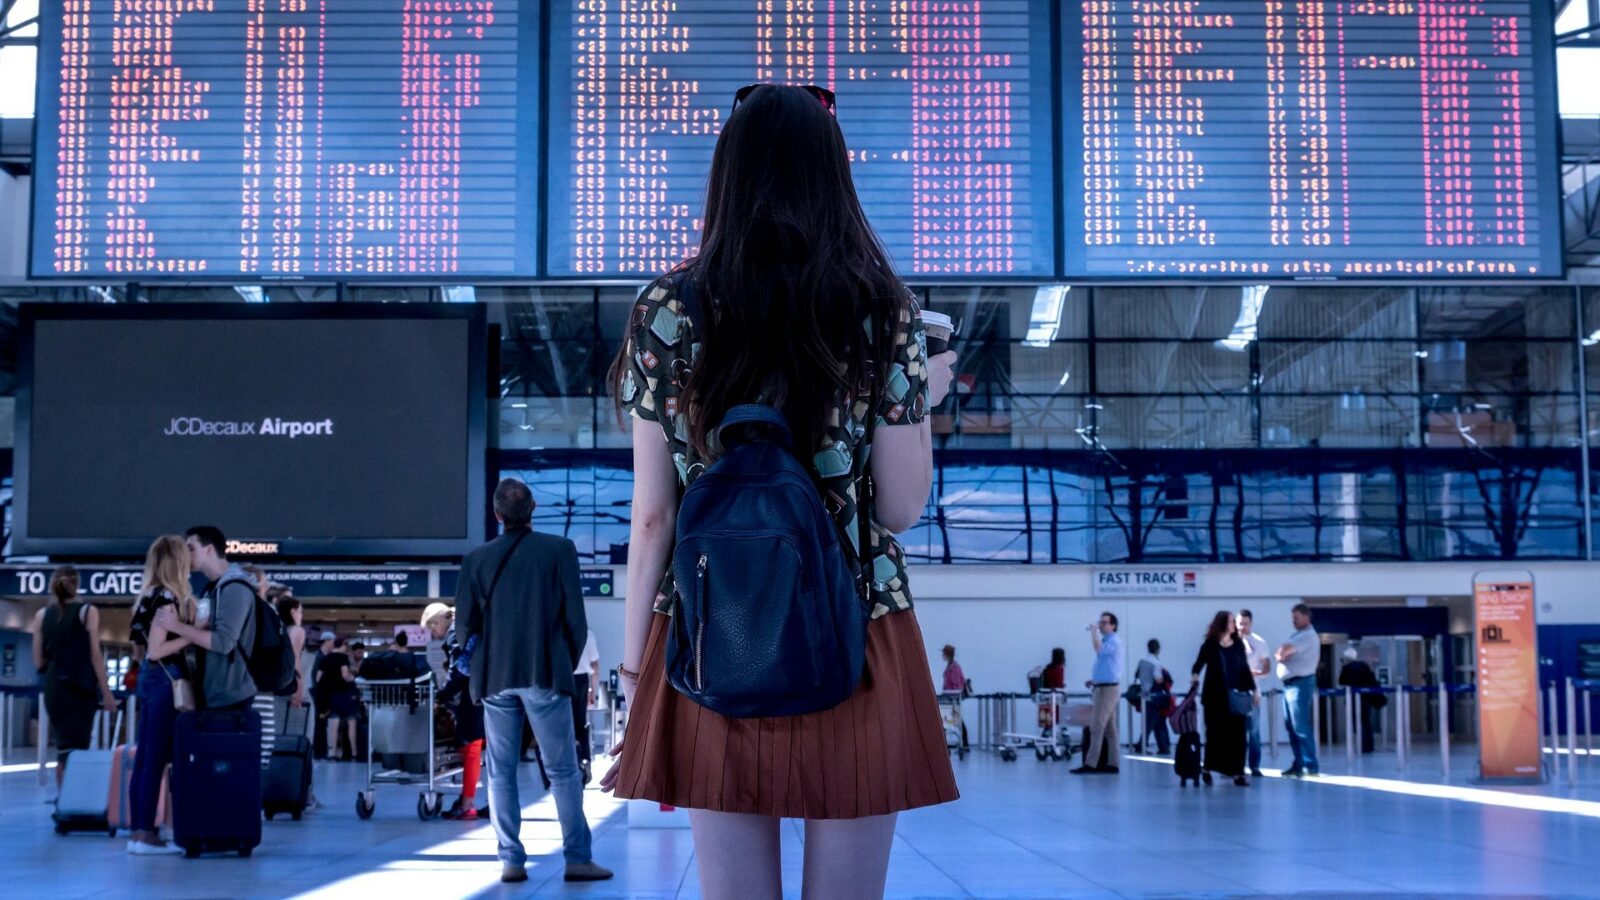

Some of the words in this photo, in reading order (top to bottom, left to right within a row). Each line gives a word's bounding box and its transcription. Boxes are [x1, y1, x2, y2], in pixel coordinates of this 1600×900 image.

[164, 417, 255, 435] JCDecaux
[259, 417, 333, 438] Airport
[225, 540, 279, 554] CDecaux
[16, 571, 46, 594] TO
[90, 572, 142, 594] GATE
[273, 573, 290, 581] YOUR
[291, 573, 323, 581] PASSPORT
[323, 573, 337, 581] AND
[338, 573, 370, 581] BOARDING
[370, 573, 386, 581] PASS
[387, 573, 409, 581] READY
[1099, 572, 1130, 584] FAST
[1135, 572, 1177, 584] TRACK
